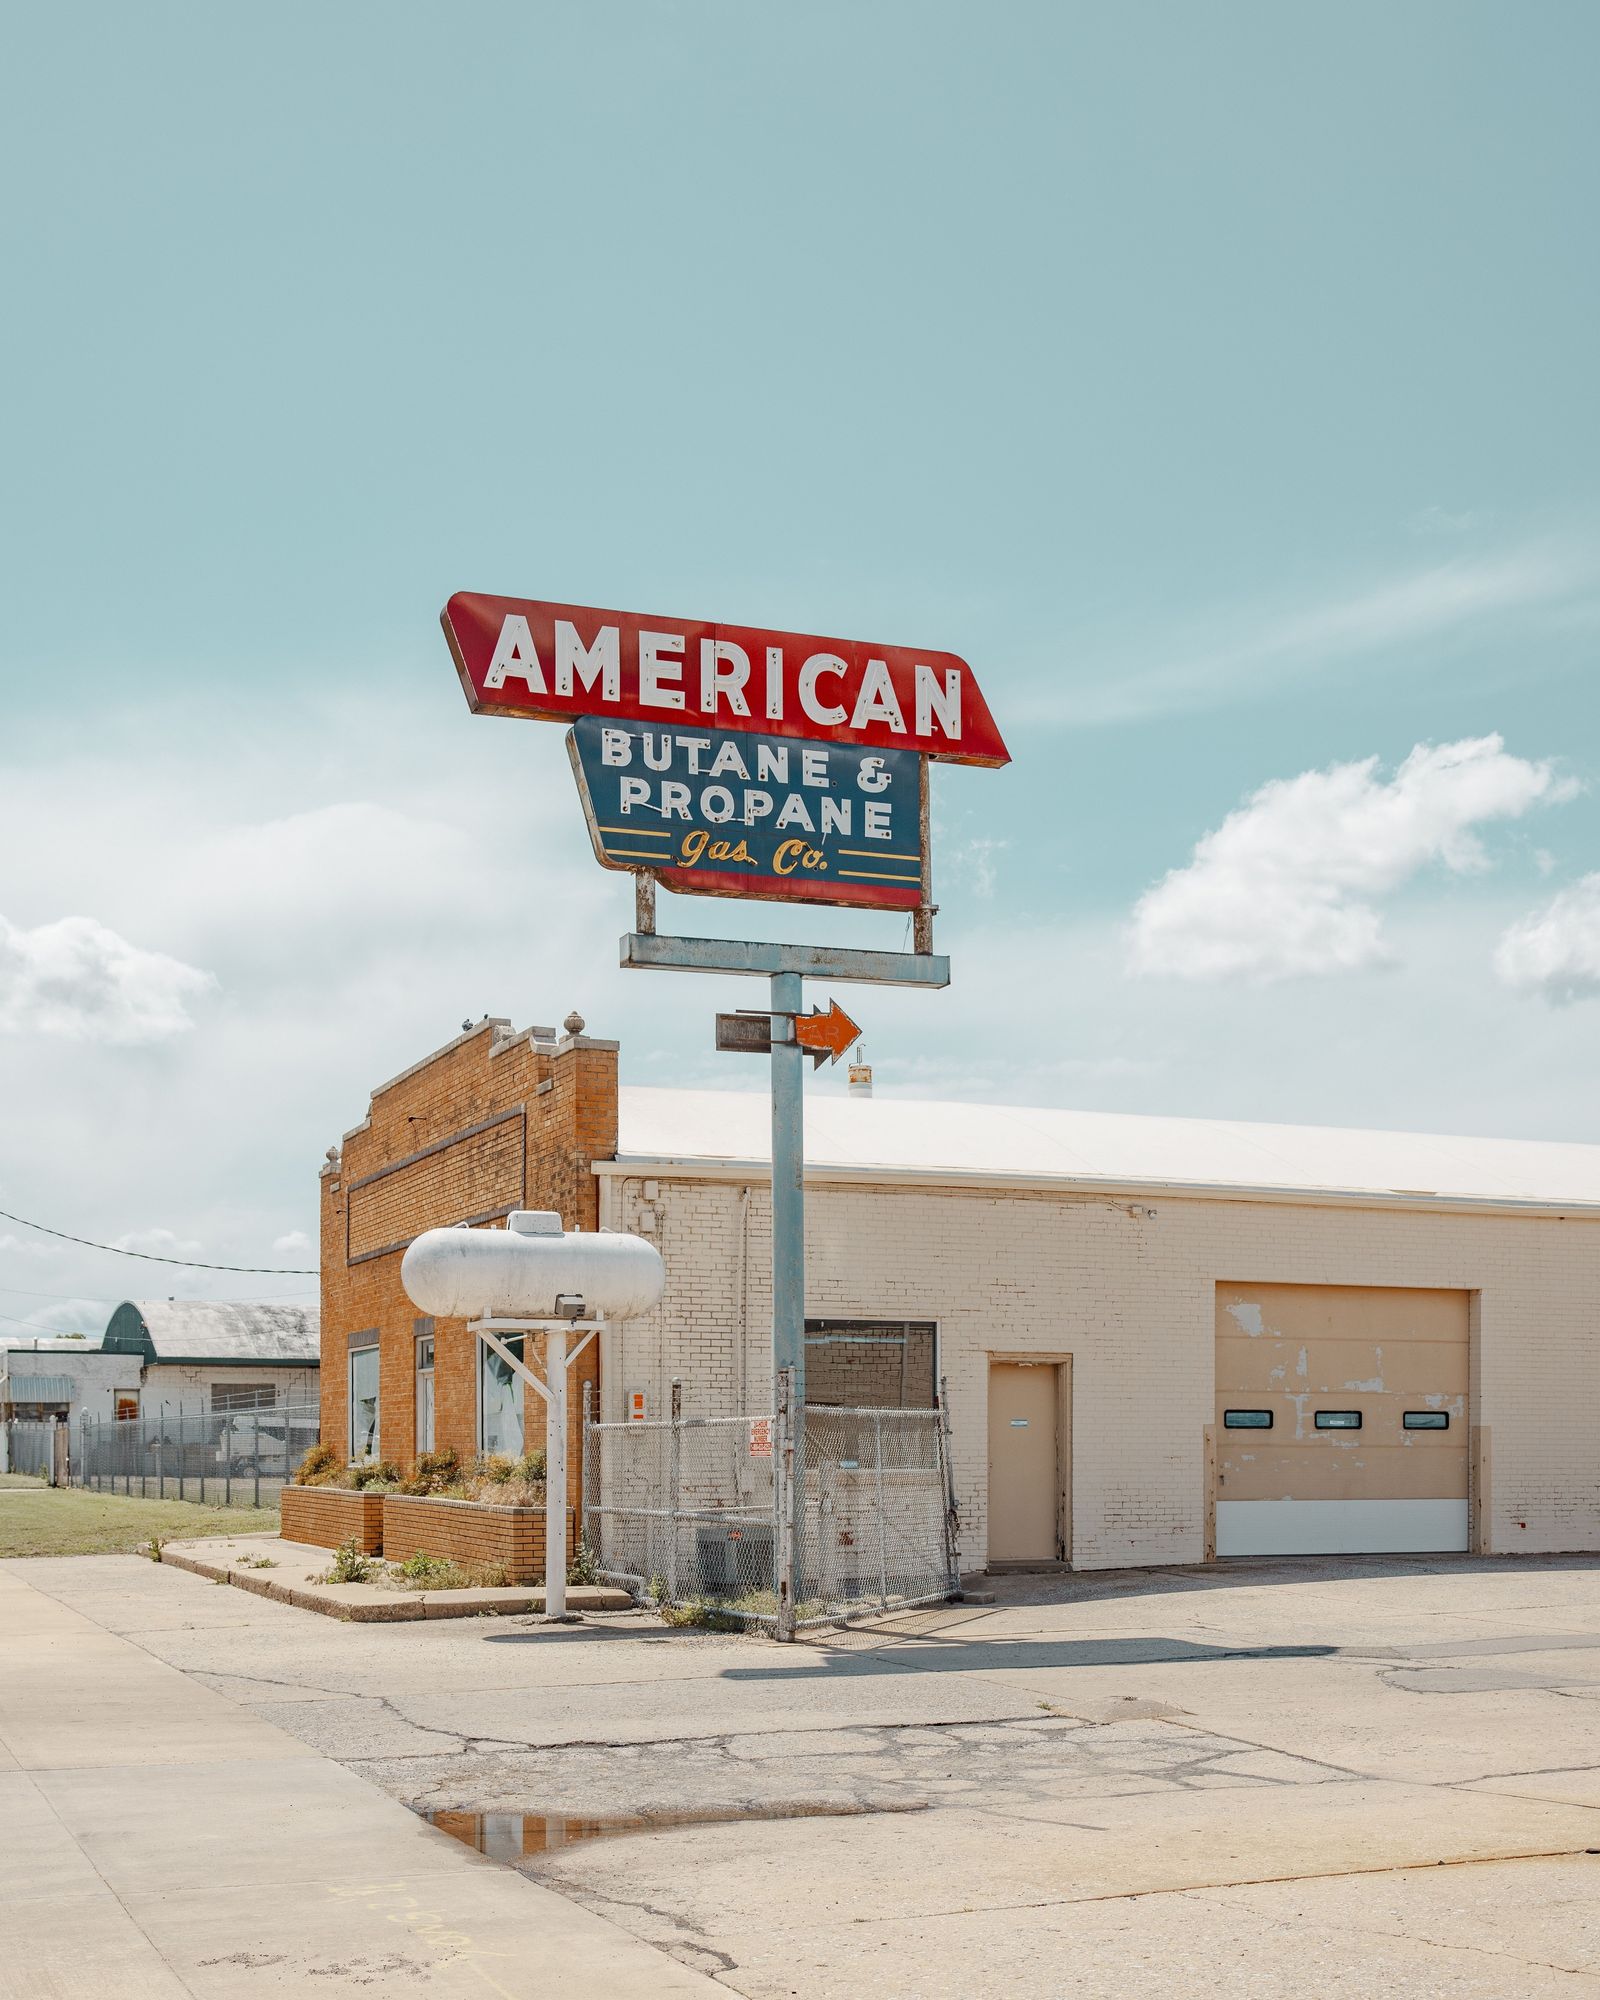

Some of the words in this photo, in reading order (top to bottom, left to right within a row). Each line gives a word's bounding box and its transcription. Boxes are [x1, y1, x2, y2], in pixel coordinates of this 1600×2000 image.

[483, 614, 962, 740] AMERICAN
[601, 727, 830, 788] BUTANE
[856, 757, 893, 793] &
[619, 775, 893, 840] PROPANE
[673, 830, 758, 868] gas
[772, 838, 828, 875] Co.
